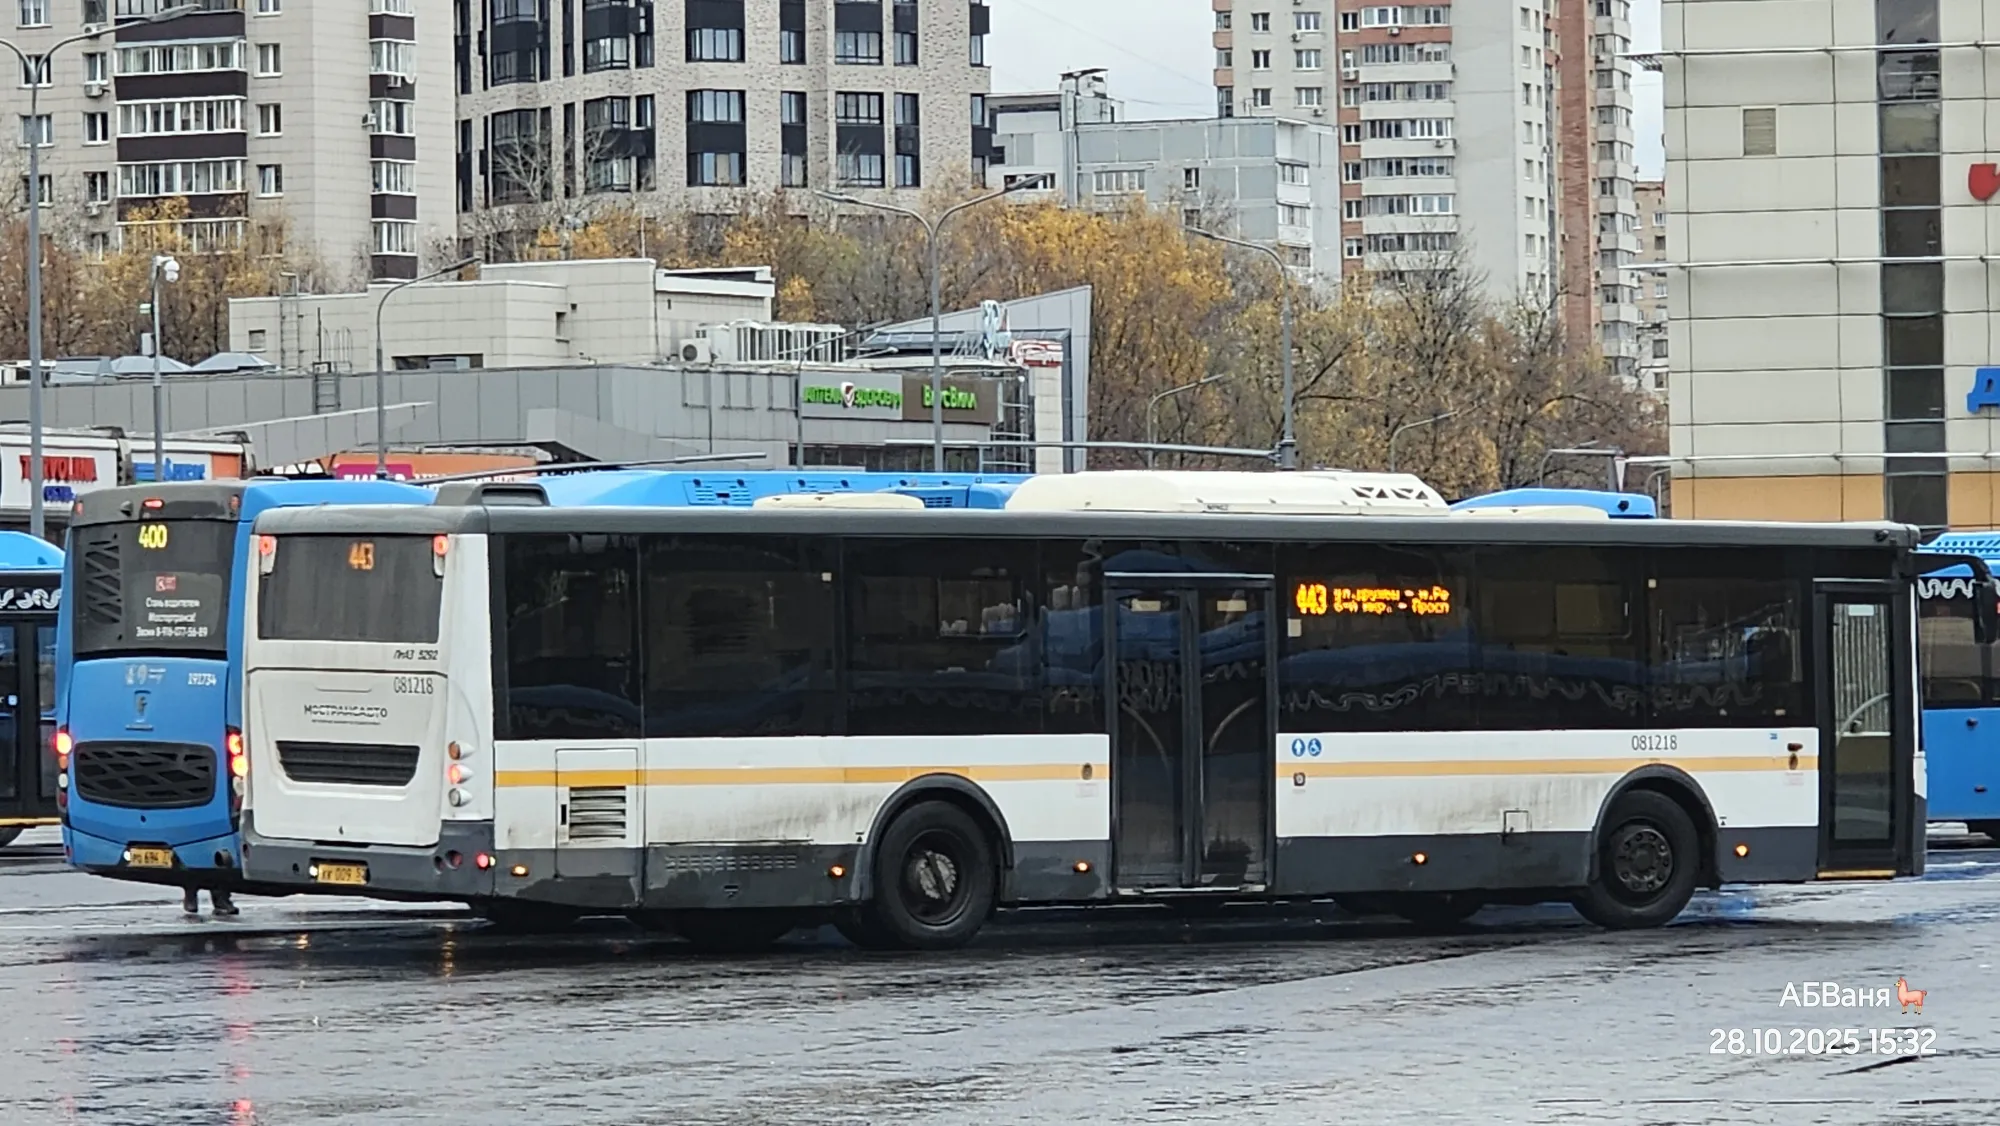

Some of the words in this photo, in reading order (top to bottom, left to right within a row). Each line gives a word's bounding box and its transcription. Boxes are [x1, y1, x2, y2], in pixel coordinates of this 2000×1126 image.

[138, 525, 168, 548] 400
[349, 542, 374, 570] 443
[1297, 584, 1327, 614] 443
[393, 676, 434, 694] 081218
[304, 704, 388, 718] МОСТРАНСАВТО
[1631, 734, 1677, 750] 081218
